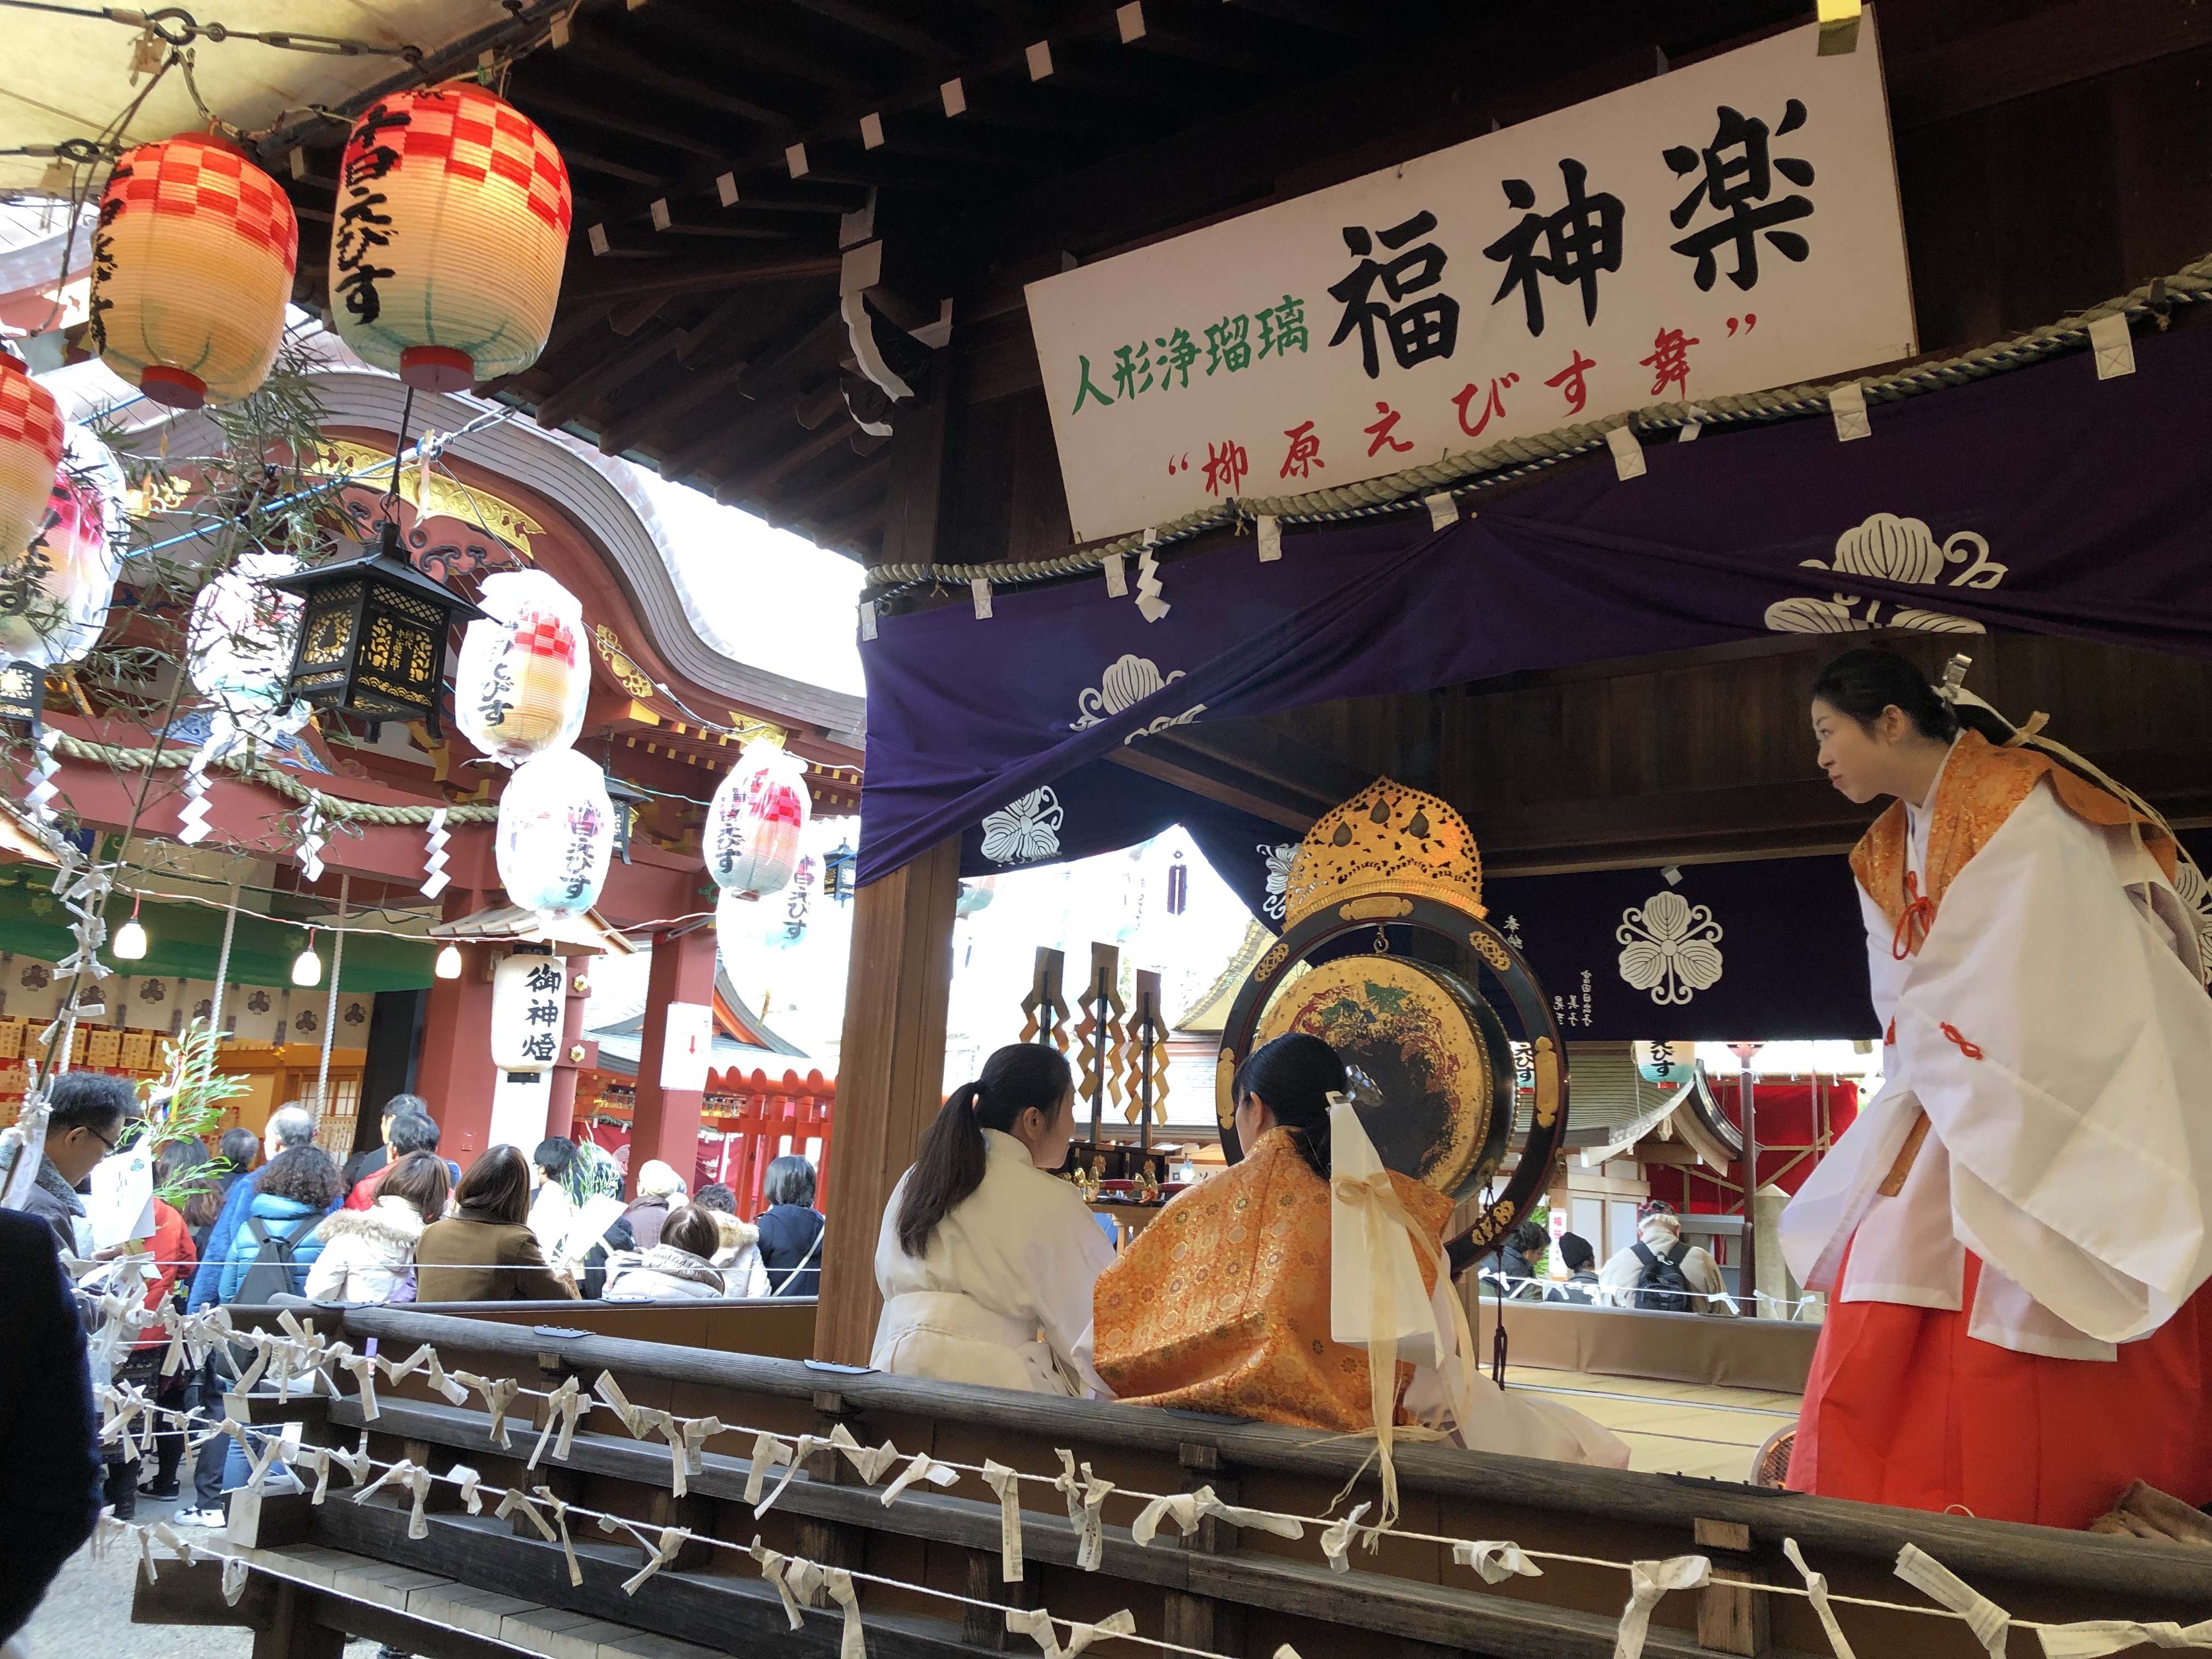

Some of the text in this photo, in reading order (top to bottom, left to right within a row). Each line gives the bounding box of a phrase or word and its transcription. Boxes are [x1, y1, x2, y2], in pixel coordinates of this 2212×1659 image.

[335, 104, 412, 325] 十日えびす
[1328, 98, 1816, 379] 福神楽
[1071, 295, 1310, 416] 人形浄瑠璃
[521, 963, 562, 1061] 御神燈
